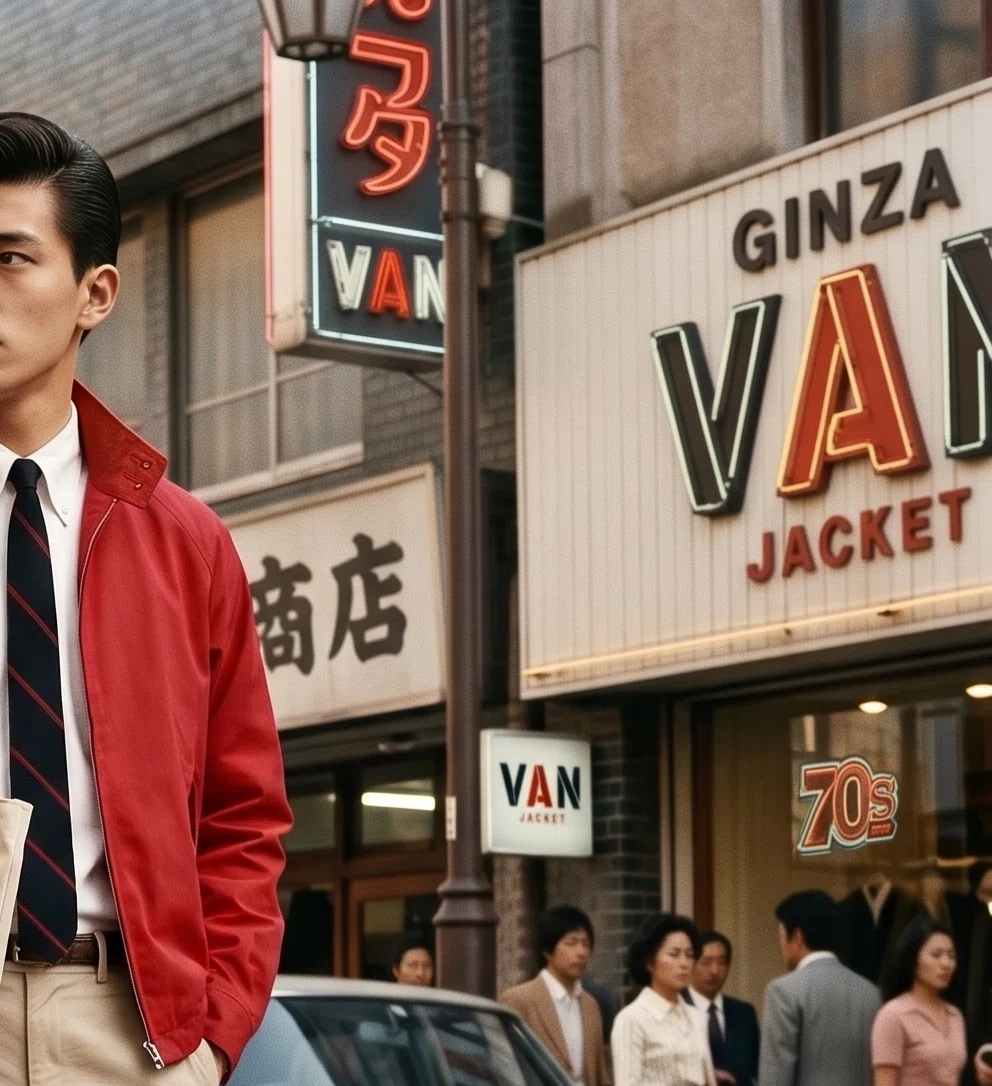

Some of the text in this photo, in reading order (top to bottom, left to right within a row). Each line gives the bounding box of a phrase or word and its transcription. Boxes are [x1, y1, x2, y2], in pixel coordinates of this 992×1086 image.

[732, 147, 960, 273] GINZA
[326, 239, 445, 324] VAN
[746, 487, 972, 584] JACKET
[248, 532, 407, 676] 商店
[499, 762, 581, 810] VAN
[519, 812, 567, 825] JACKET
